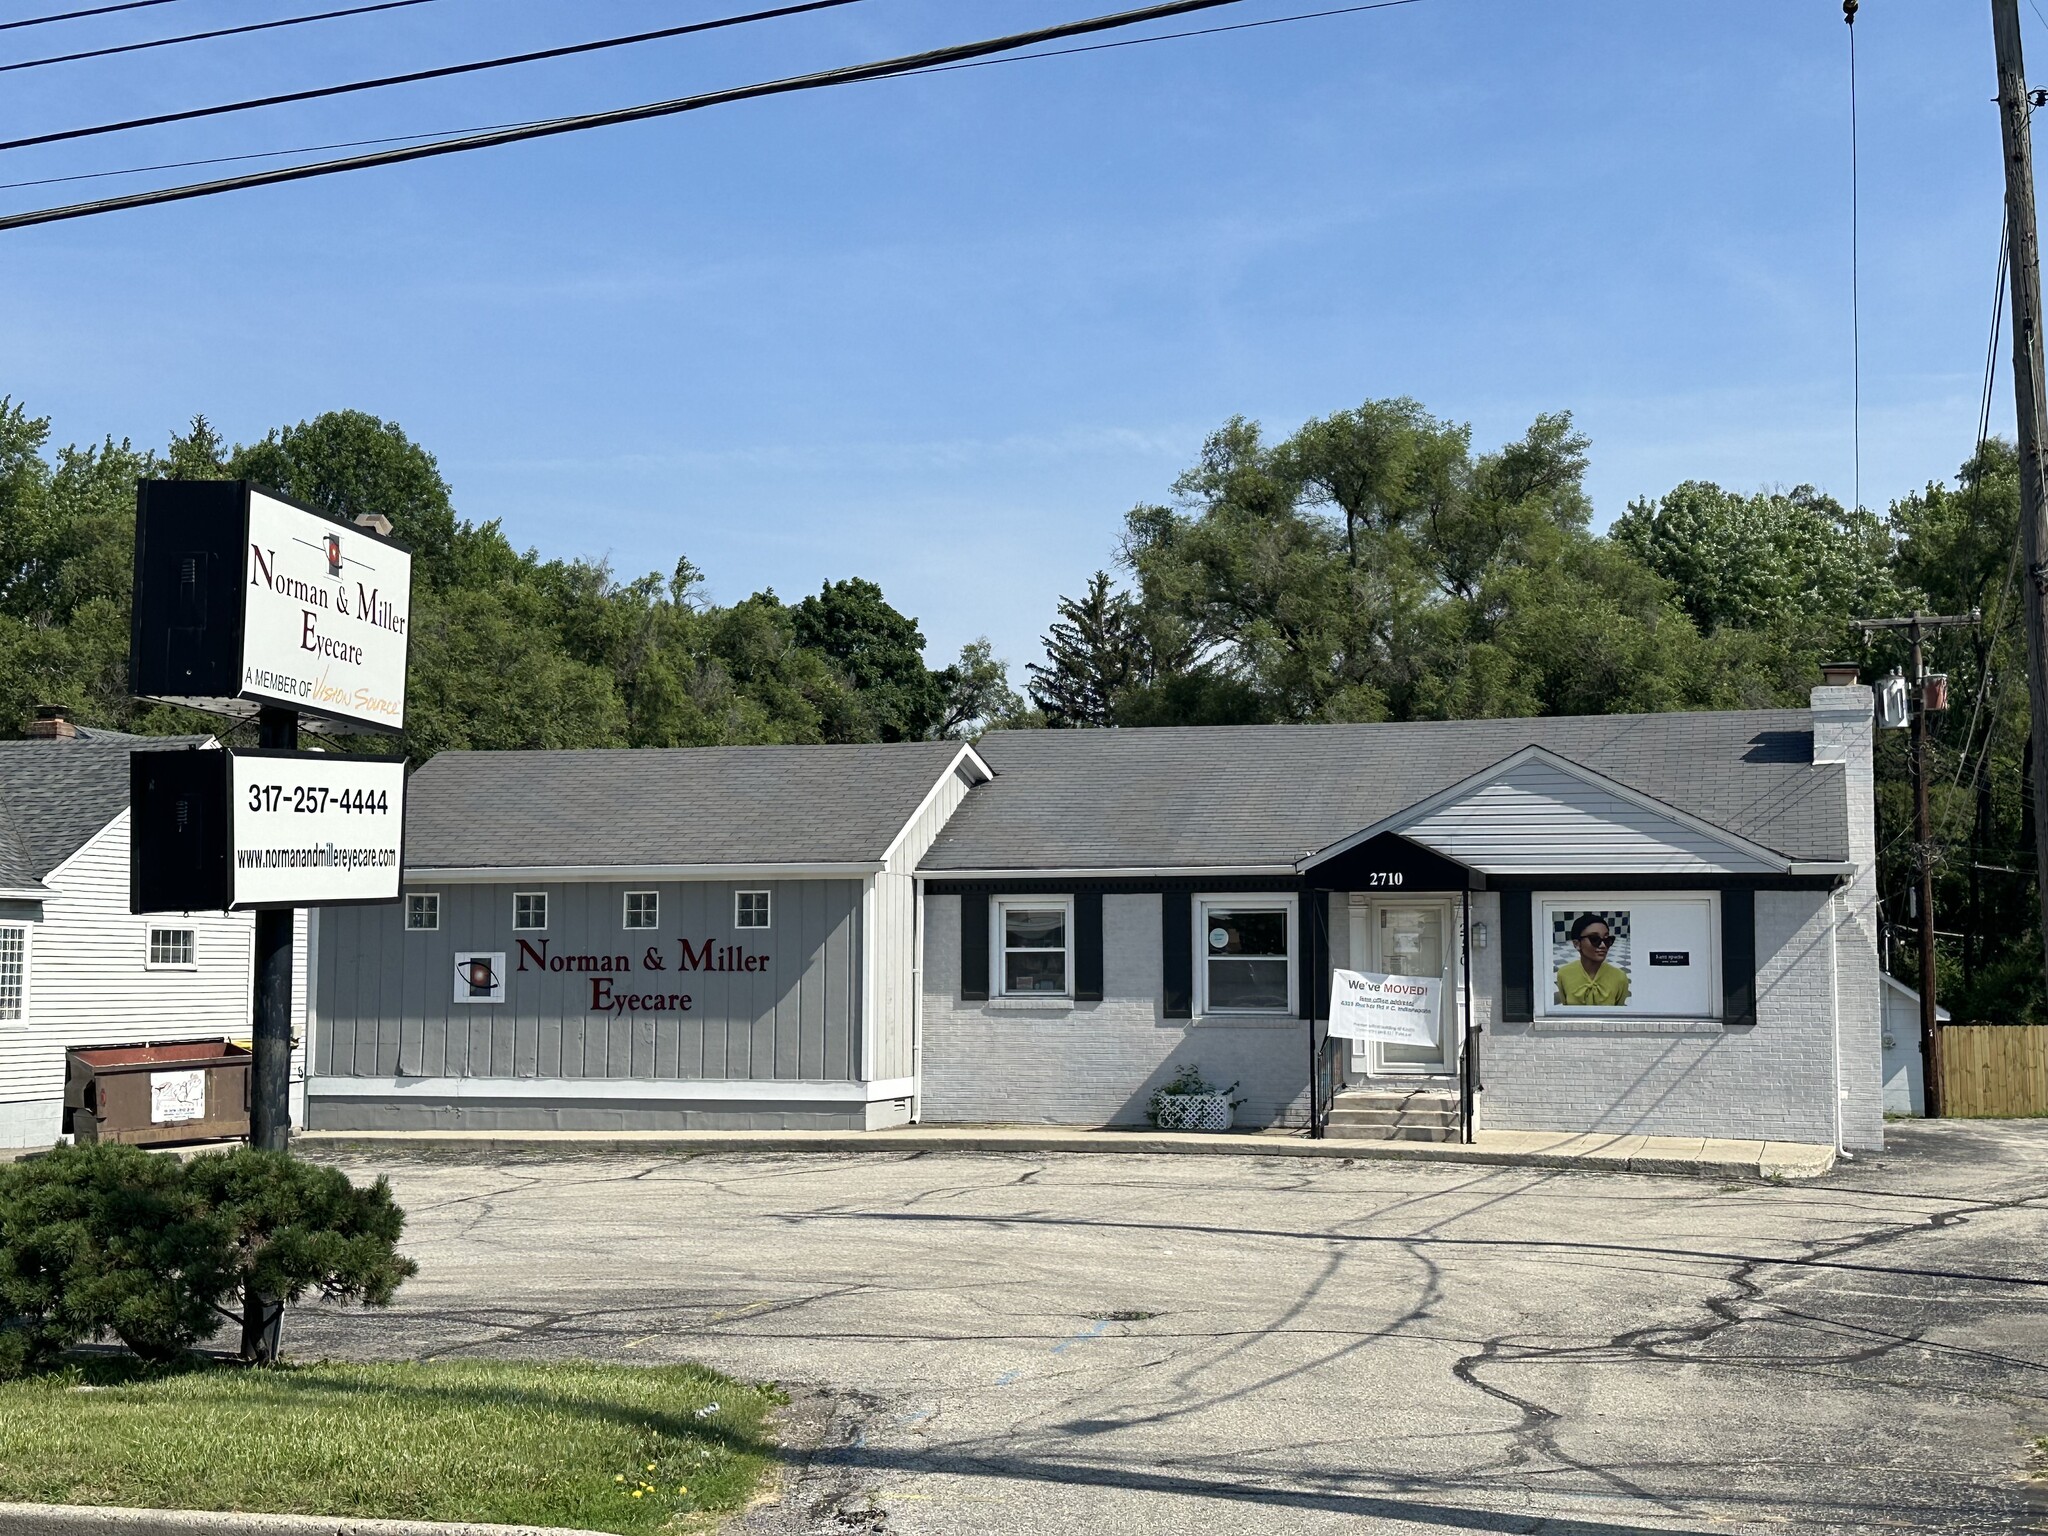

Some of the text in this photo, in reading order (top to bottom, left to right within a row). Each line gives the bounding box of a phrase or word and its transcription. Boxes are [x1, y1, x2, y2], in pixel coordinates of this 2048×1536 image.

[250, 543, 406, 635] Norman & Miller
[300, 609, 363, 666] Eyecare
[244, 666, 253, 685] A
[254, 668, 297, 696] MEMBER
[298, 680, 313, 699] OF
[248, 784, 388, 815] 317-257-4444
[237, 842, 396, 872] www.normanandmillereyecare.com
[1369, 872, 1403, 886] 2710
[515, 937, 770, 973] Norman & Miller
[589, 977, 693, 1020] Eyecare
[1348, 979, 1428, 996] We've MOVED!
